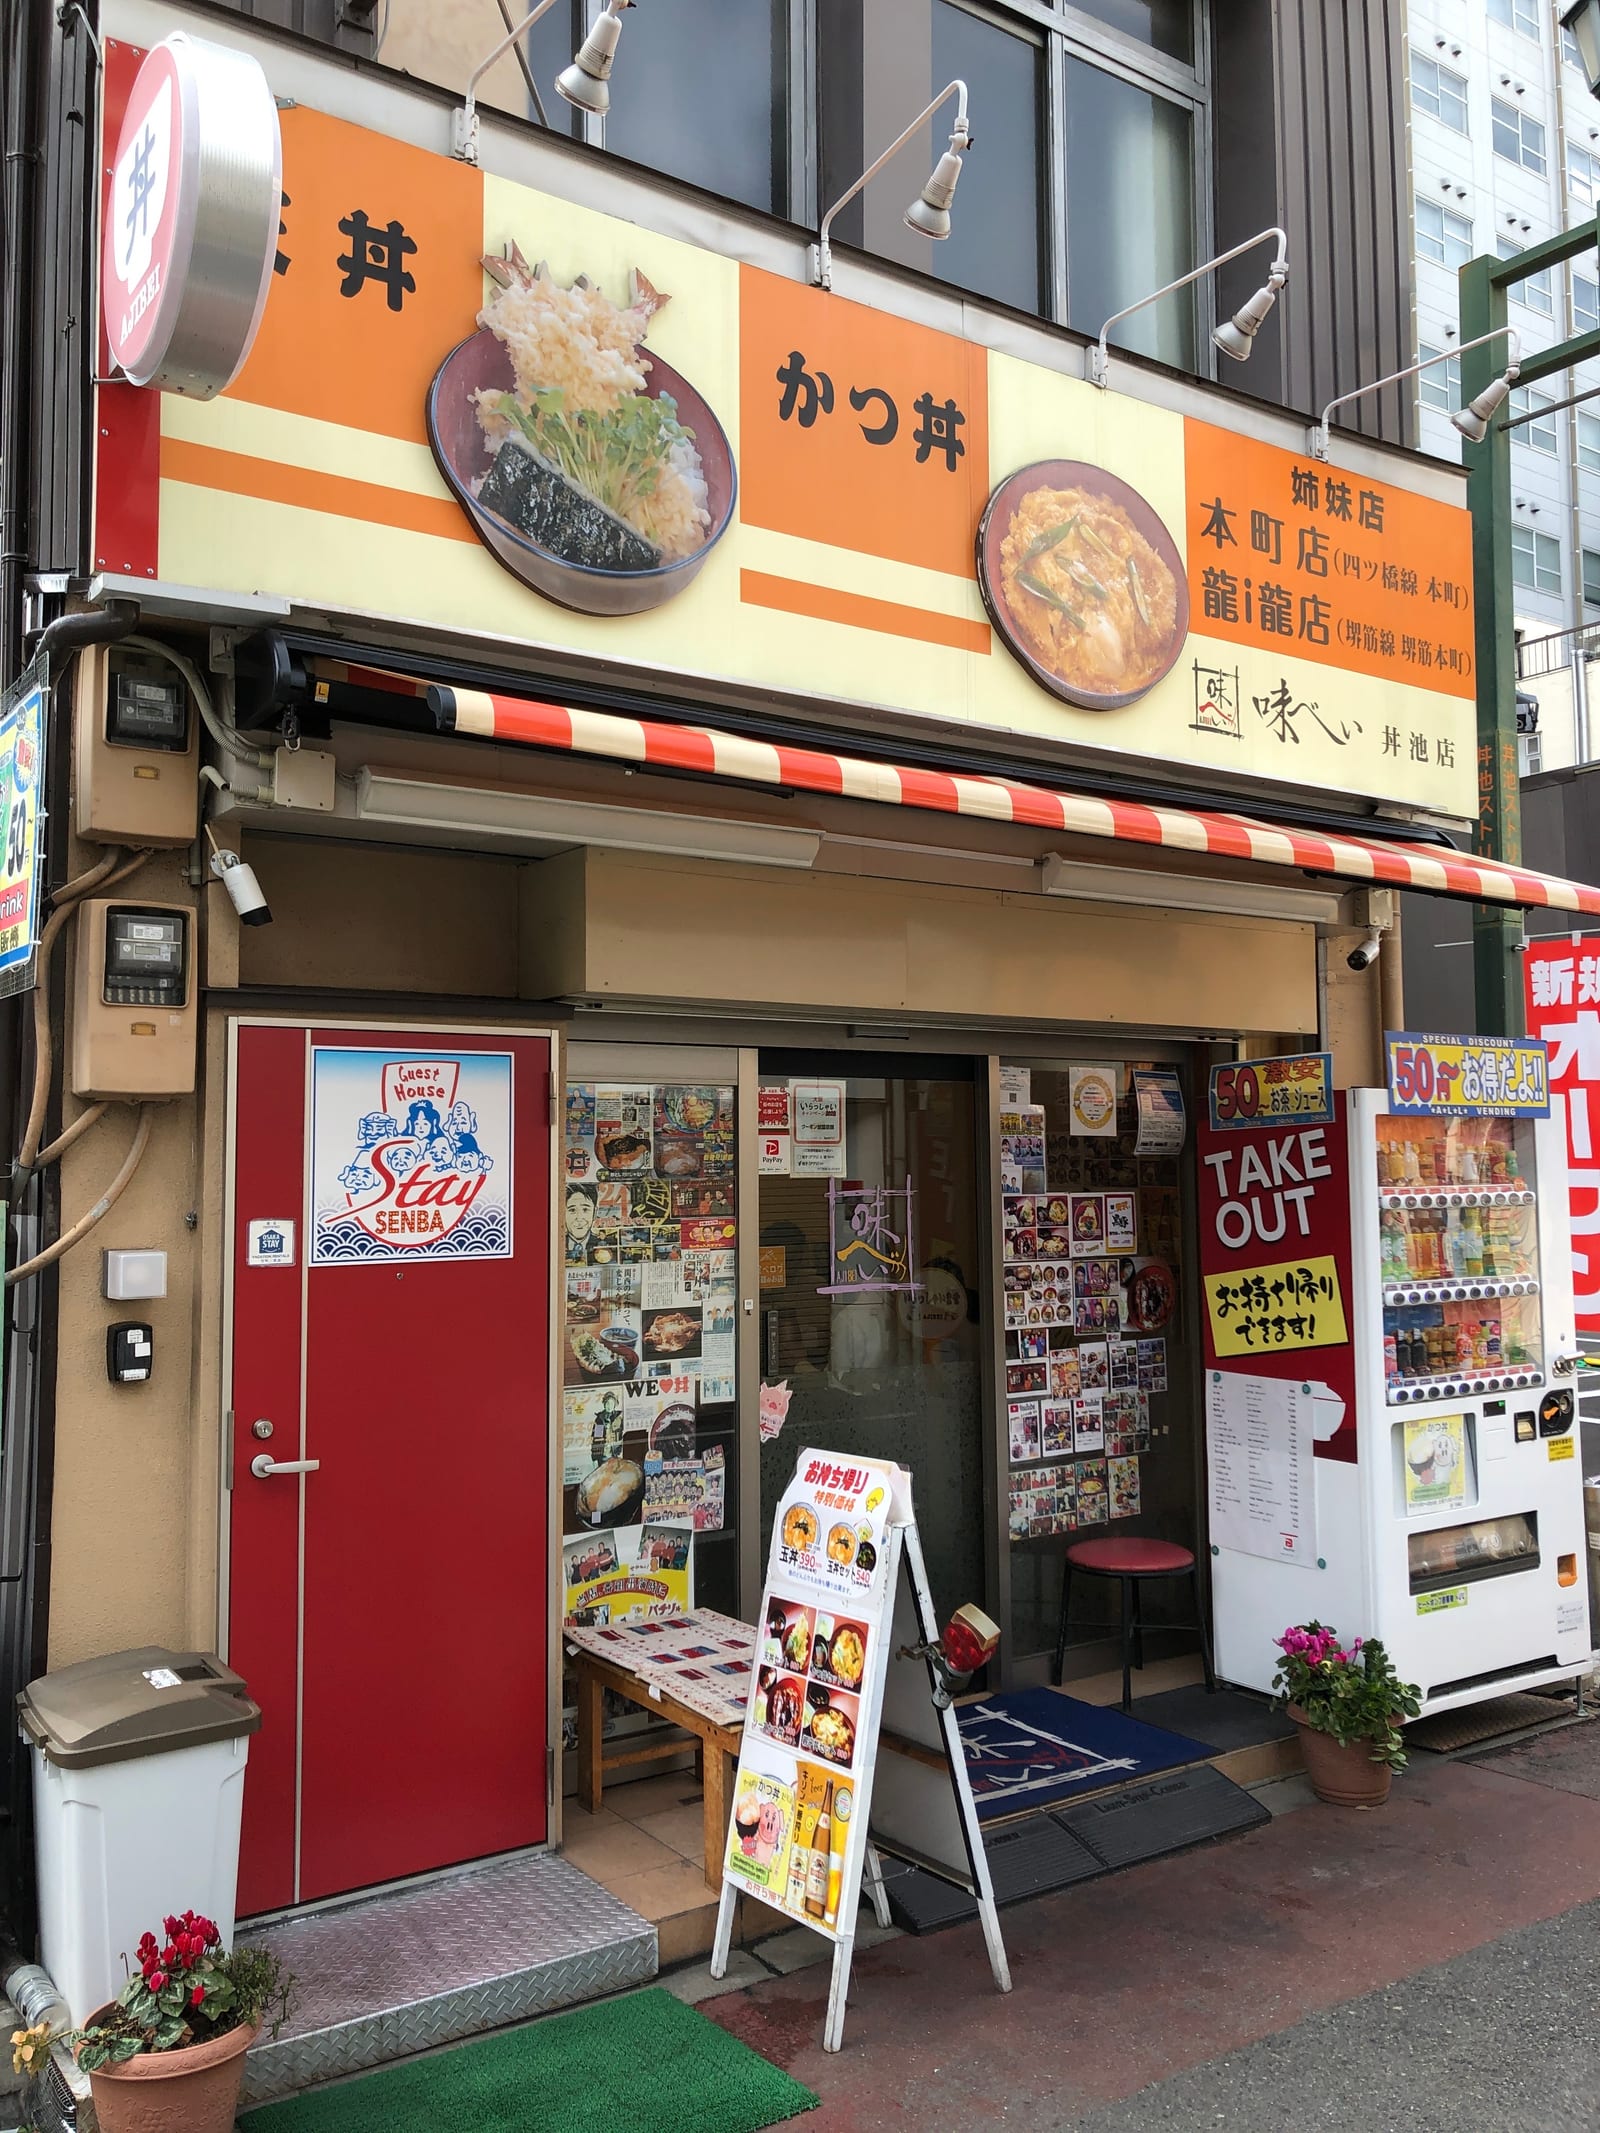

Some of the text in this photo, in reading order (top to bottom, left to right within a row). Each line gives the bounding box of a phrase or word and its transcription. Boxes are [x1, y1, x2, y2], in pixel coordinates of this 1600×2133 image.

[119, 261, 162, 347] AJIBEI
[775, 350, 967, 473] かつ丼
[1290, 465, 1385, 534] 姉妹店
[1200, 497, 1330, 578] 本町店
[1381, 725, 1456, 769] 丼池店
[1422, 1034, 1515, 1048] SPECIAL DISCOUNT
[398, 1065, 440, 1083] Guest
[1263, 1057, 1322, 1085] 激安
[393, 1083, 446, 1102] House
[799, 1103, 837, 1111] いらっしゃい
[1476, 1107, 1517, 1116] VENDING
[762, 1156, 783, 1165] PayPay
[1204, 1128, 1333, 1198] TAKE
[325, 1140, 487, 1224] Stay
[375, 1209, 445, 1234] SENBA
[1215, 1185, 1317, 1249] OUT
[262, 1239, 281, 1249] STAY
[1214, 1267, 1335, 1319] お持ち帰り
[624, 1379, 659, 1398] WE
[803, 1459, 870, 1495] お持ち帰り
[778, 1545, 799, 1567] 玉丼
[798, 1552, 816, 1568] 390
[855, 1569, 871, 1584] 540
[758, 1779, 780, 1801] かつ丼
